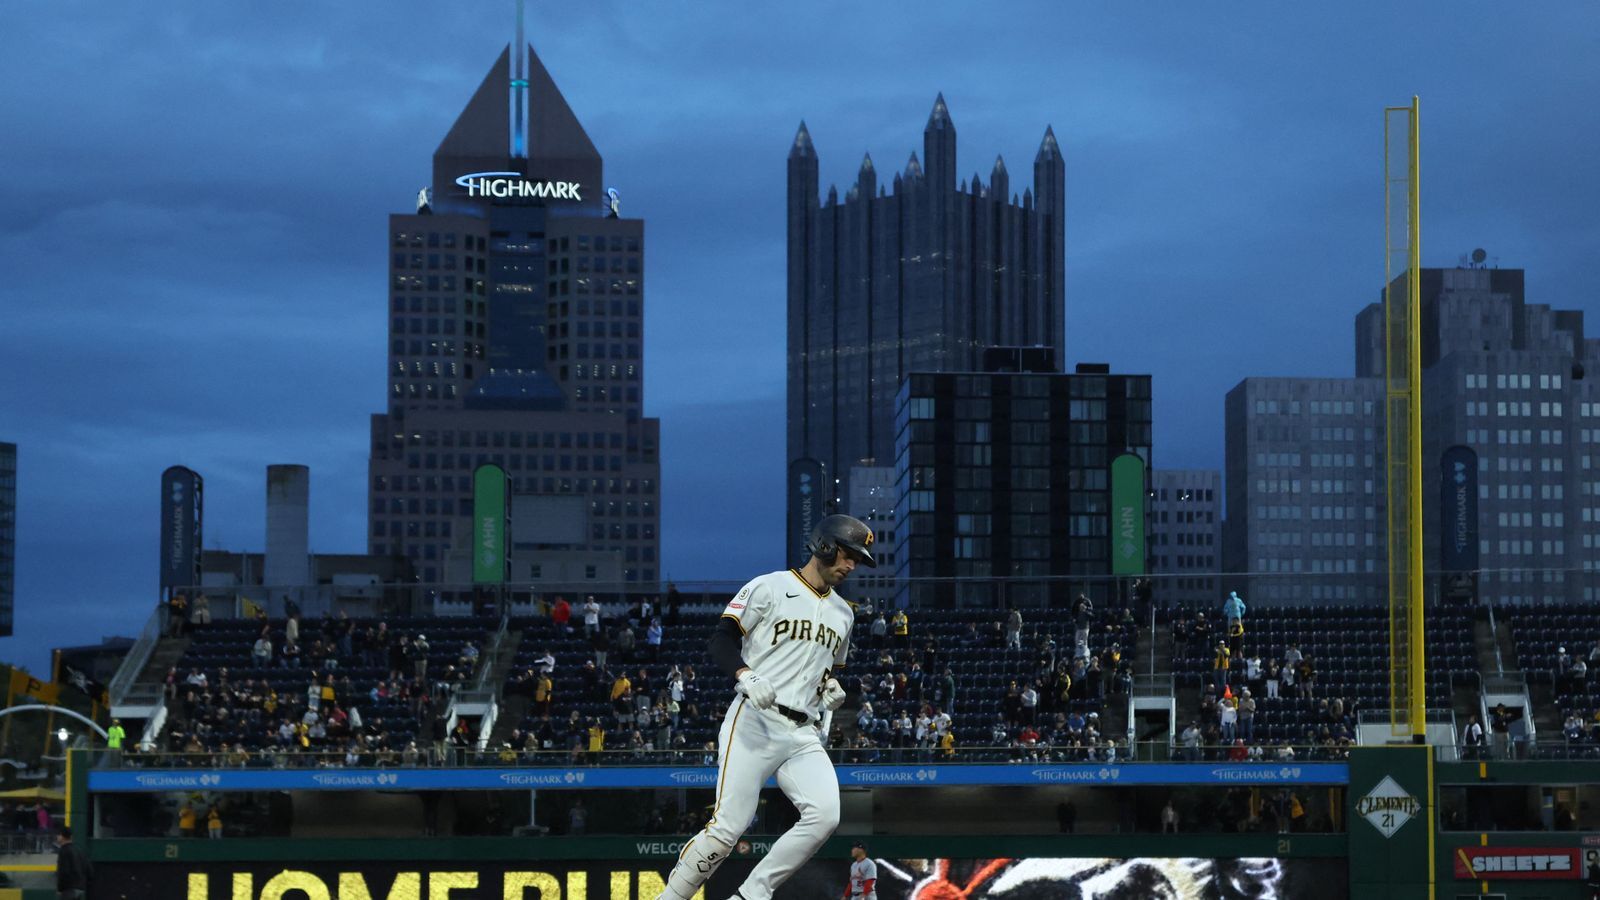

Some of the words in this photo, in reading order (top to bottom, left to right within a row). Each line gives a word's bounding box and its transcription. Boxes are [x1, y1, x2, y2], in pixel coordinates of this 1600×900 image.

[467, 176, 582, 201] HIGHMARK
[1121, 506, 1135, 539] AHN
[1456, 486, 1467, 548] HIGHMARK
[172, 504, 184, 565] HIGHMARK
[483, 517, 496, 550] AHN
[865, 531, 874, 545] P
[140, 774, 199, 786] HIGHMARK
[317, 774, 375, 785] HIGHMARK
[504, 774, 562, 785] HIGHMARK
[855, 771, 913, 782] HIGHMARK
[1037, 769, 1096, 780] HIGHMARK
[1216, 768, 1278, 780] HIGHMARK
[1357, 796, 1419, 818] CLEMENTE
[1382, 813, 1395, 828] 21
[165, 844, 179, 858] 21
[752, 842, 772, 854] PN
[1279, 839, 1290, 853] 21
[707, 852, 719, 861] 5
[1472, 855, 1571, 872] SHEETZ
